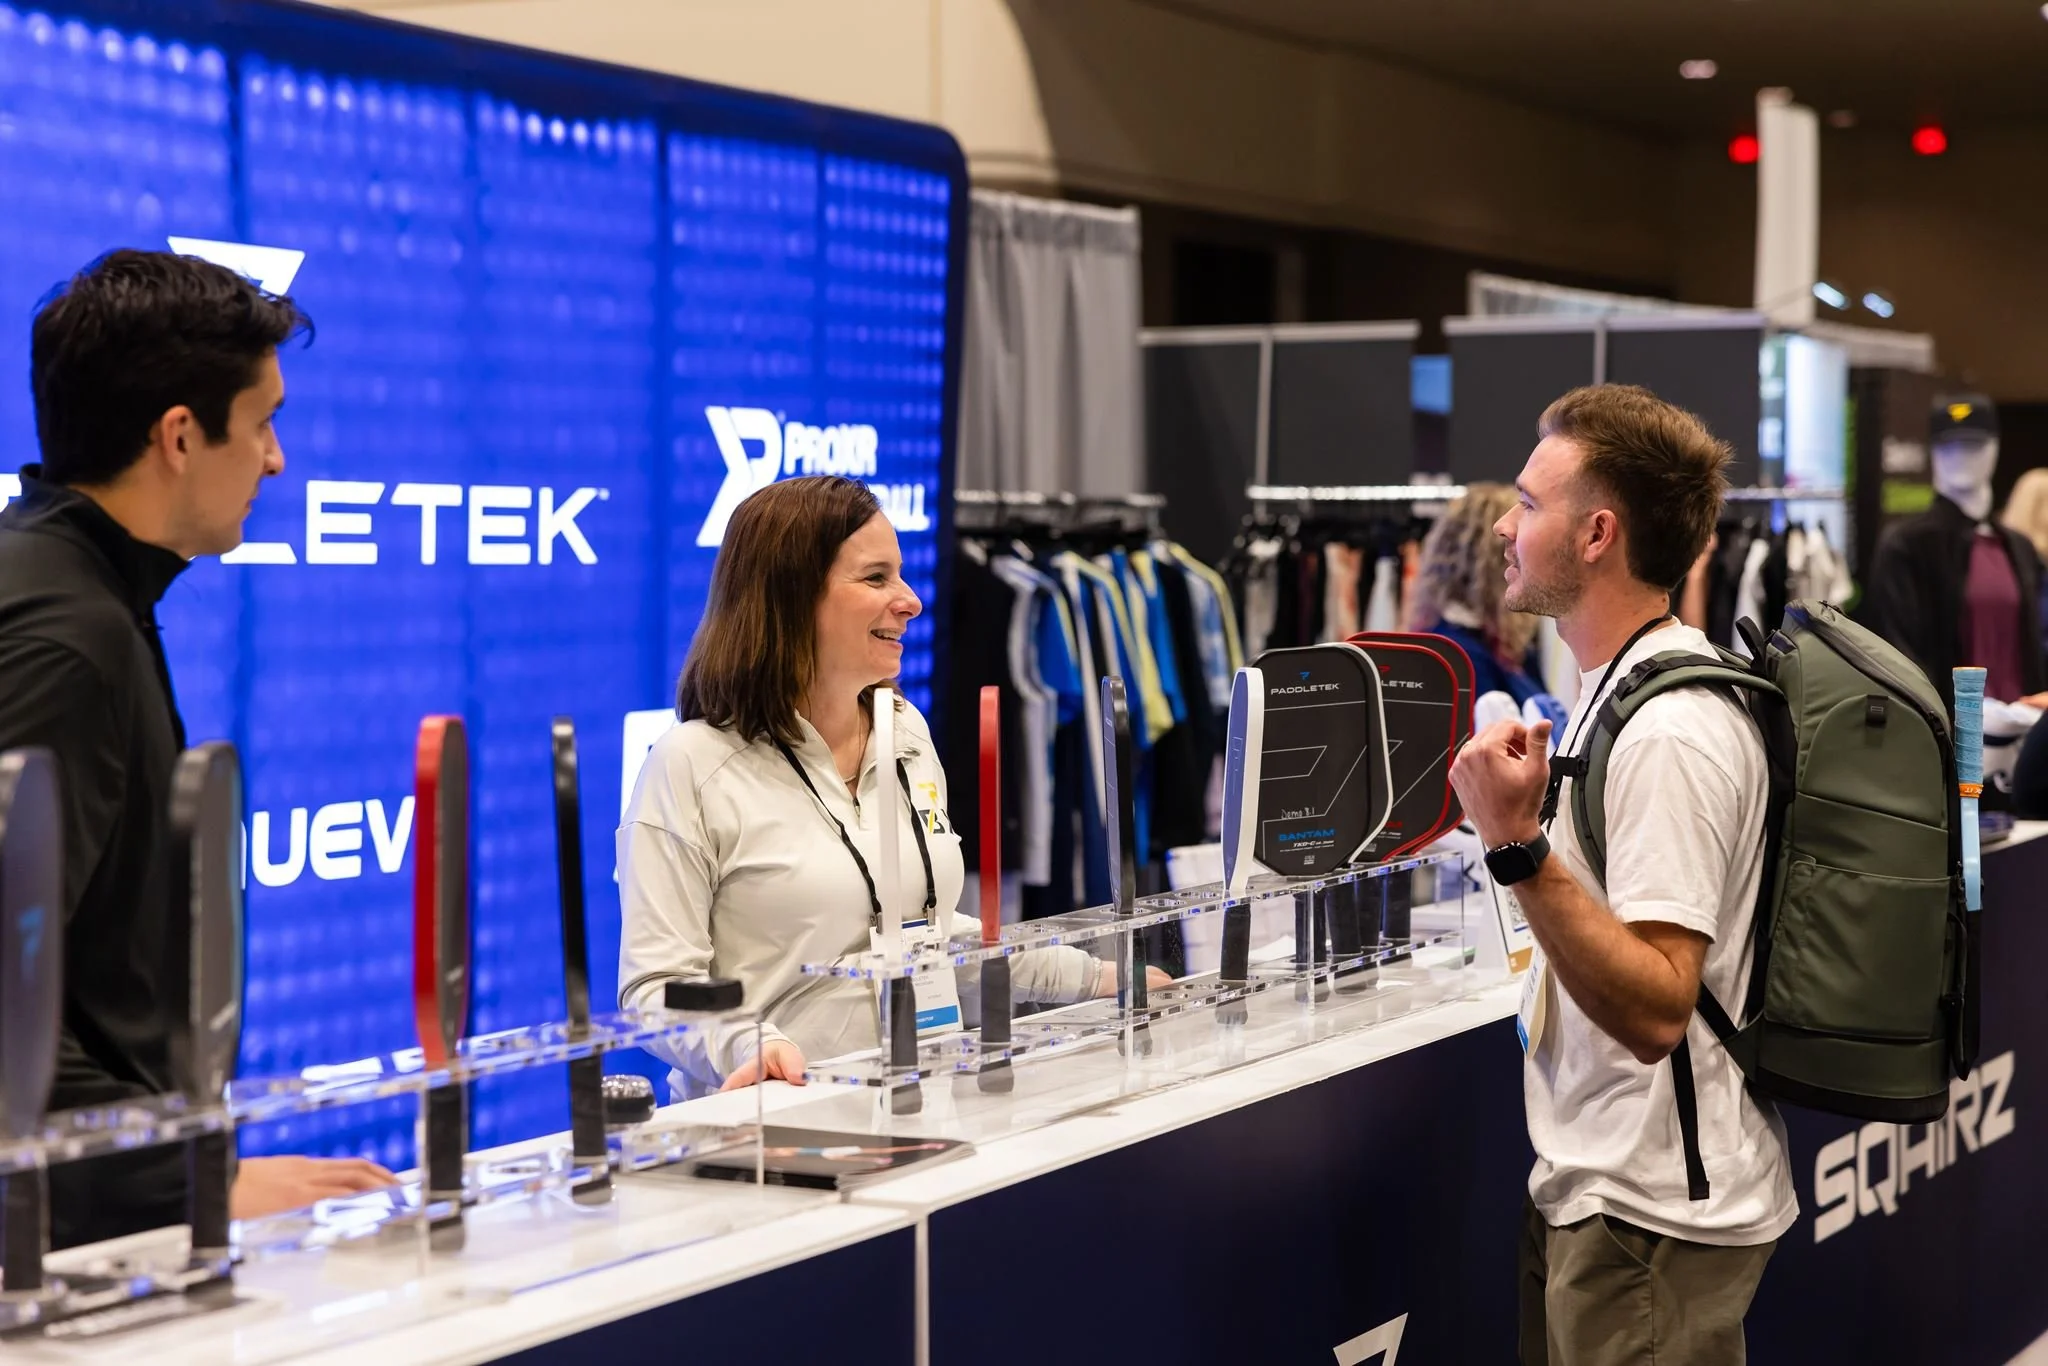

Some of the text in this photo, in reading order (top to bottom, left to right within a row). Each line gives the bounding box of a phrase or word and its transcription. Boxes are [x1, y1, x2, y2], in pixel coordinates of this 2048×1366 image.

[220, 480, 599, 565] LETEK
[1270, 683, 1340, 695] PADDLETEK
[1380, 679, 1424, 689] LETEK
[1279, 829, 1335, 841] BANTAM
[241, 796, 416, 889] UEV
